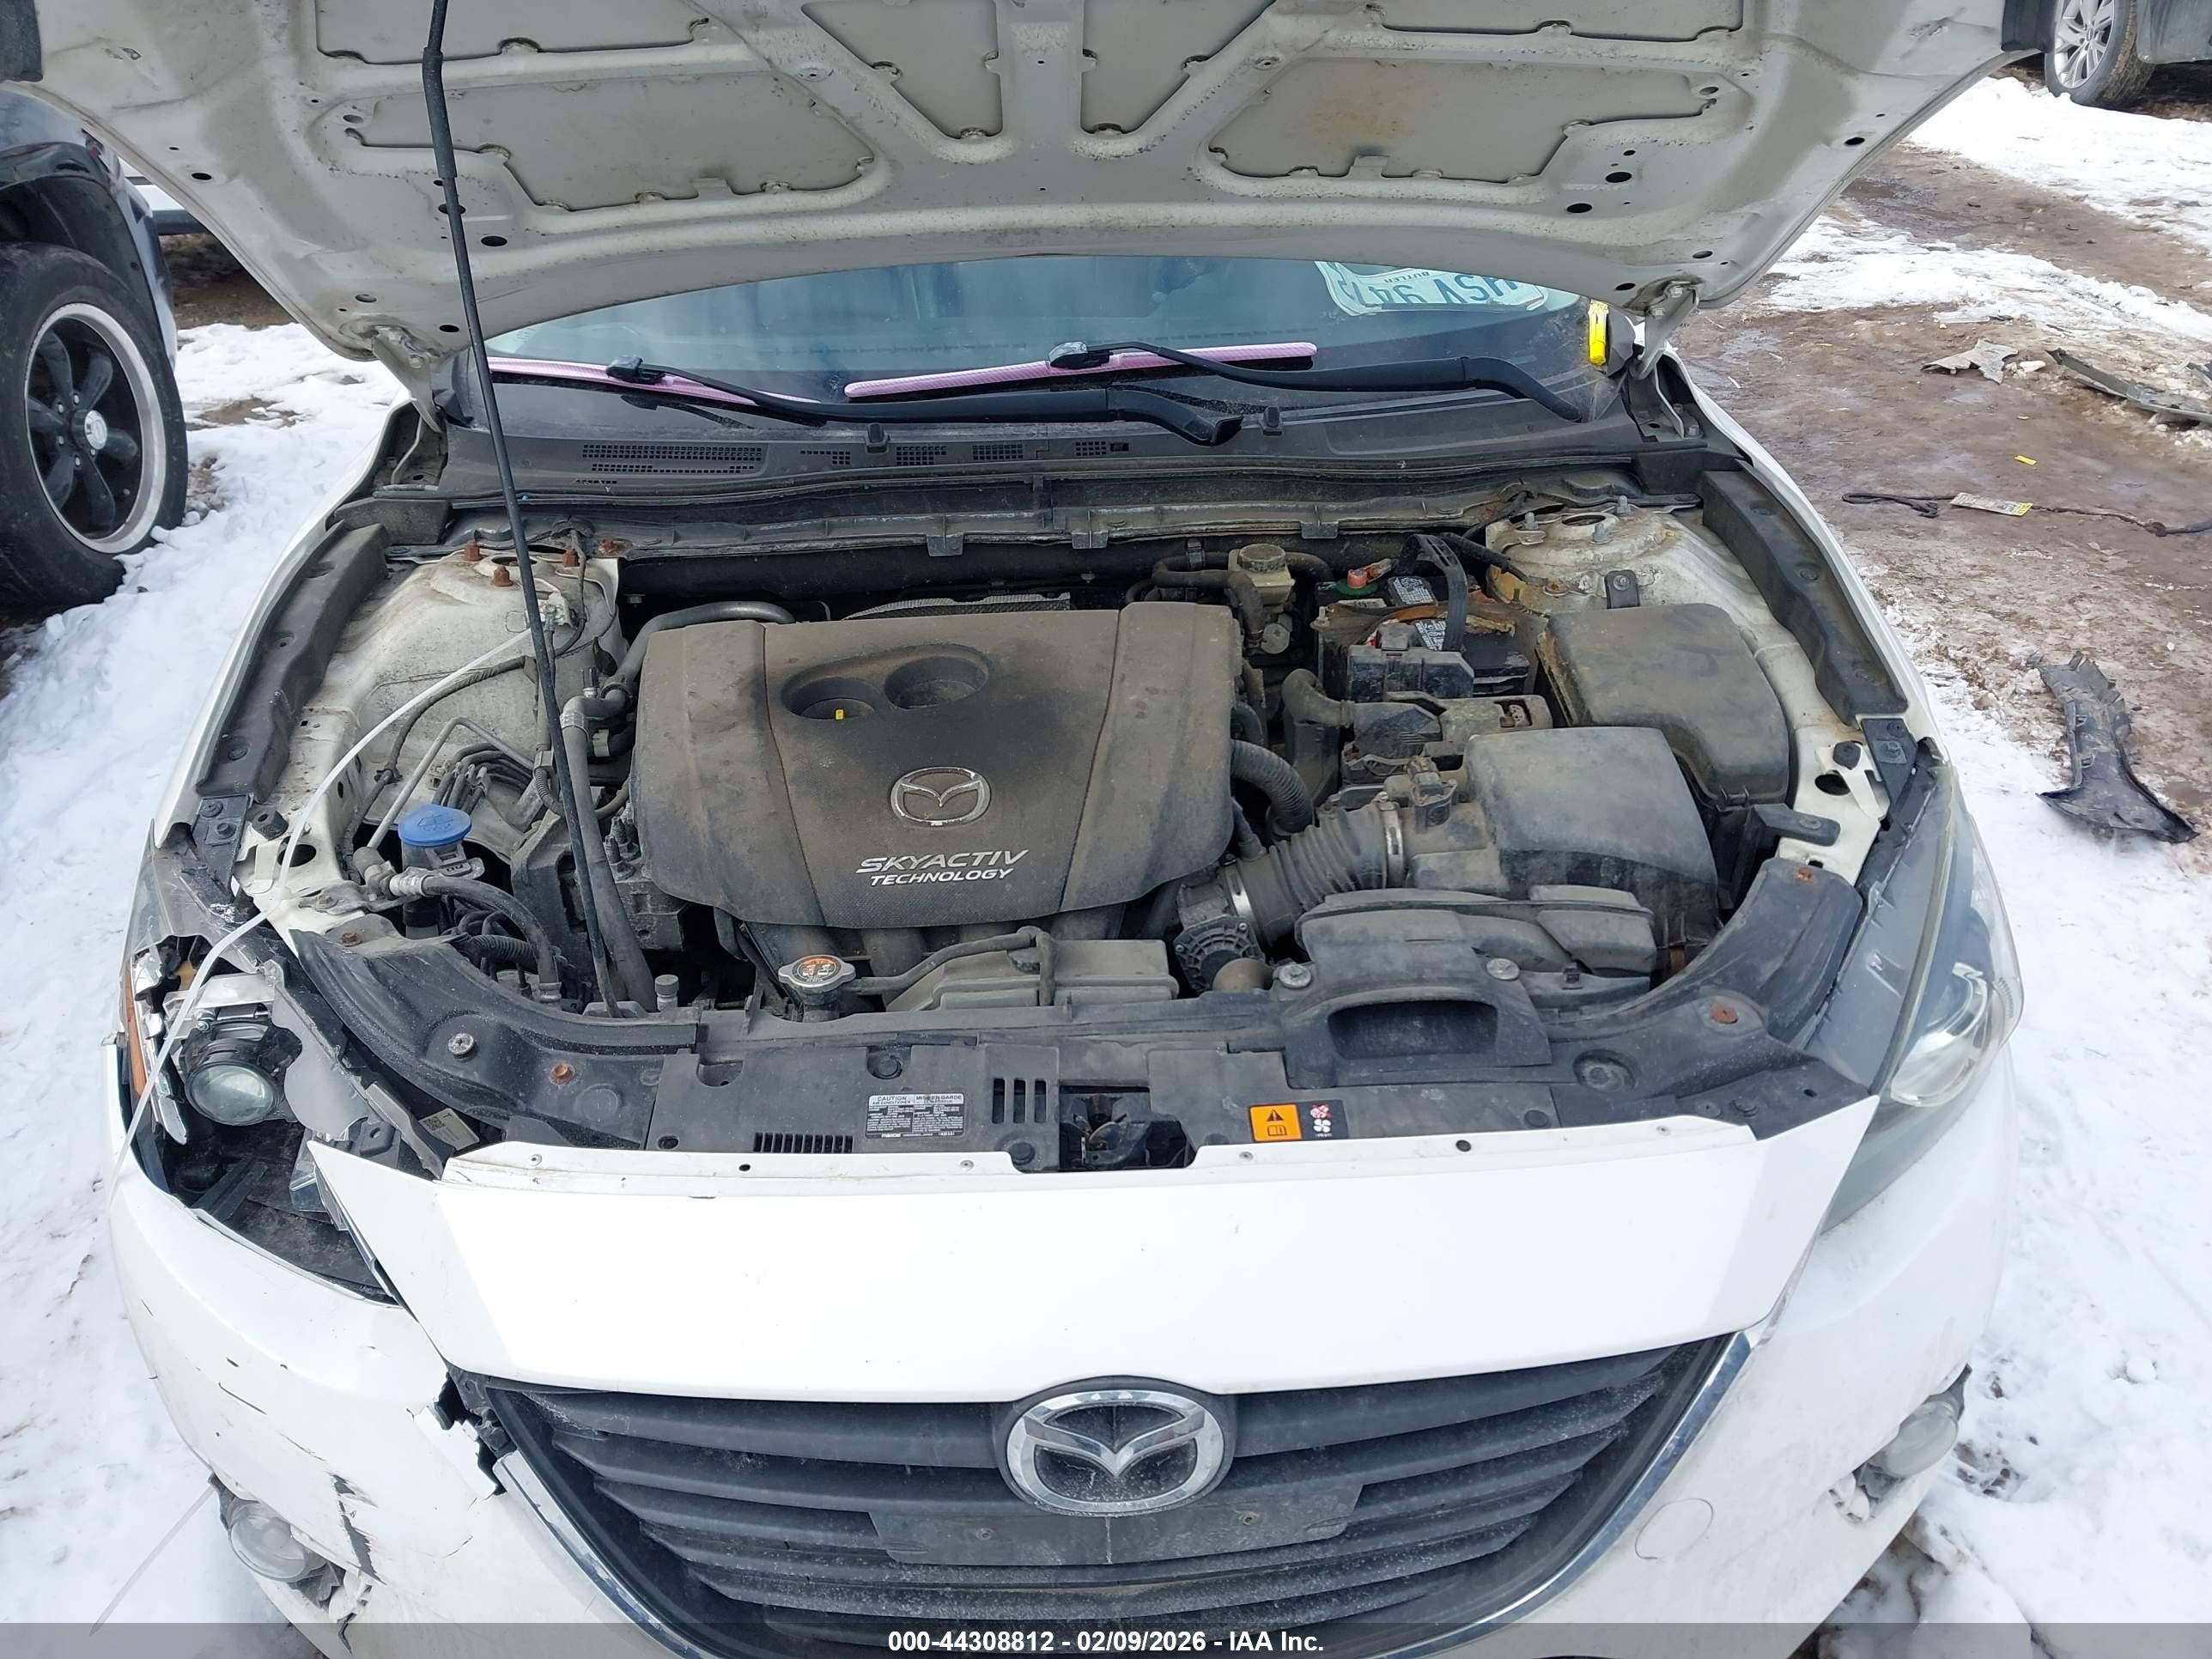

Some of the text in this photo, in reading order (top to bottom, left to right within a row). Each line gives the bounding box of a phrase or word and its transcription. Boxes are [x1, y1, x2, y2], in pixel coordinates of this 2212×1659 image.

[1384, 271, 1430, 284] BUTLER
[856, 849, 1029, 873] SKYACTIV
[871, 868, 1014, 886] TECHNOLOGY
